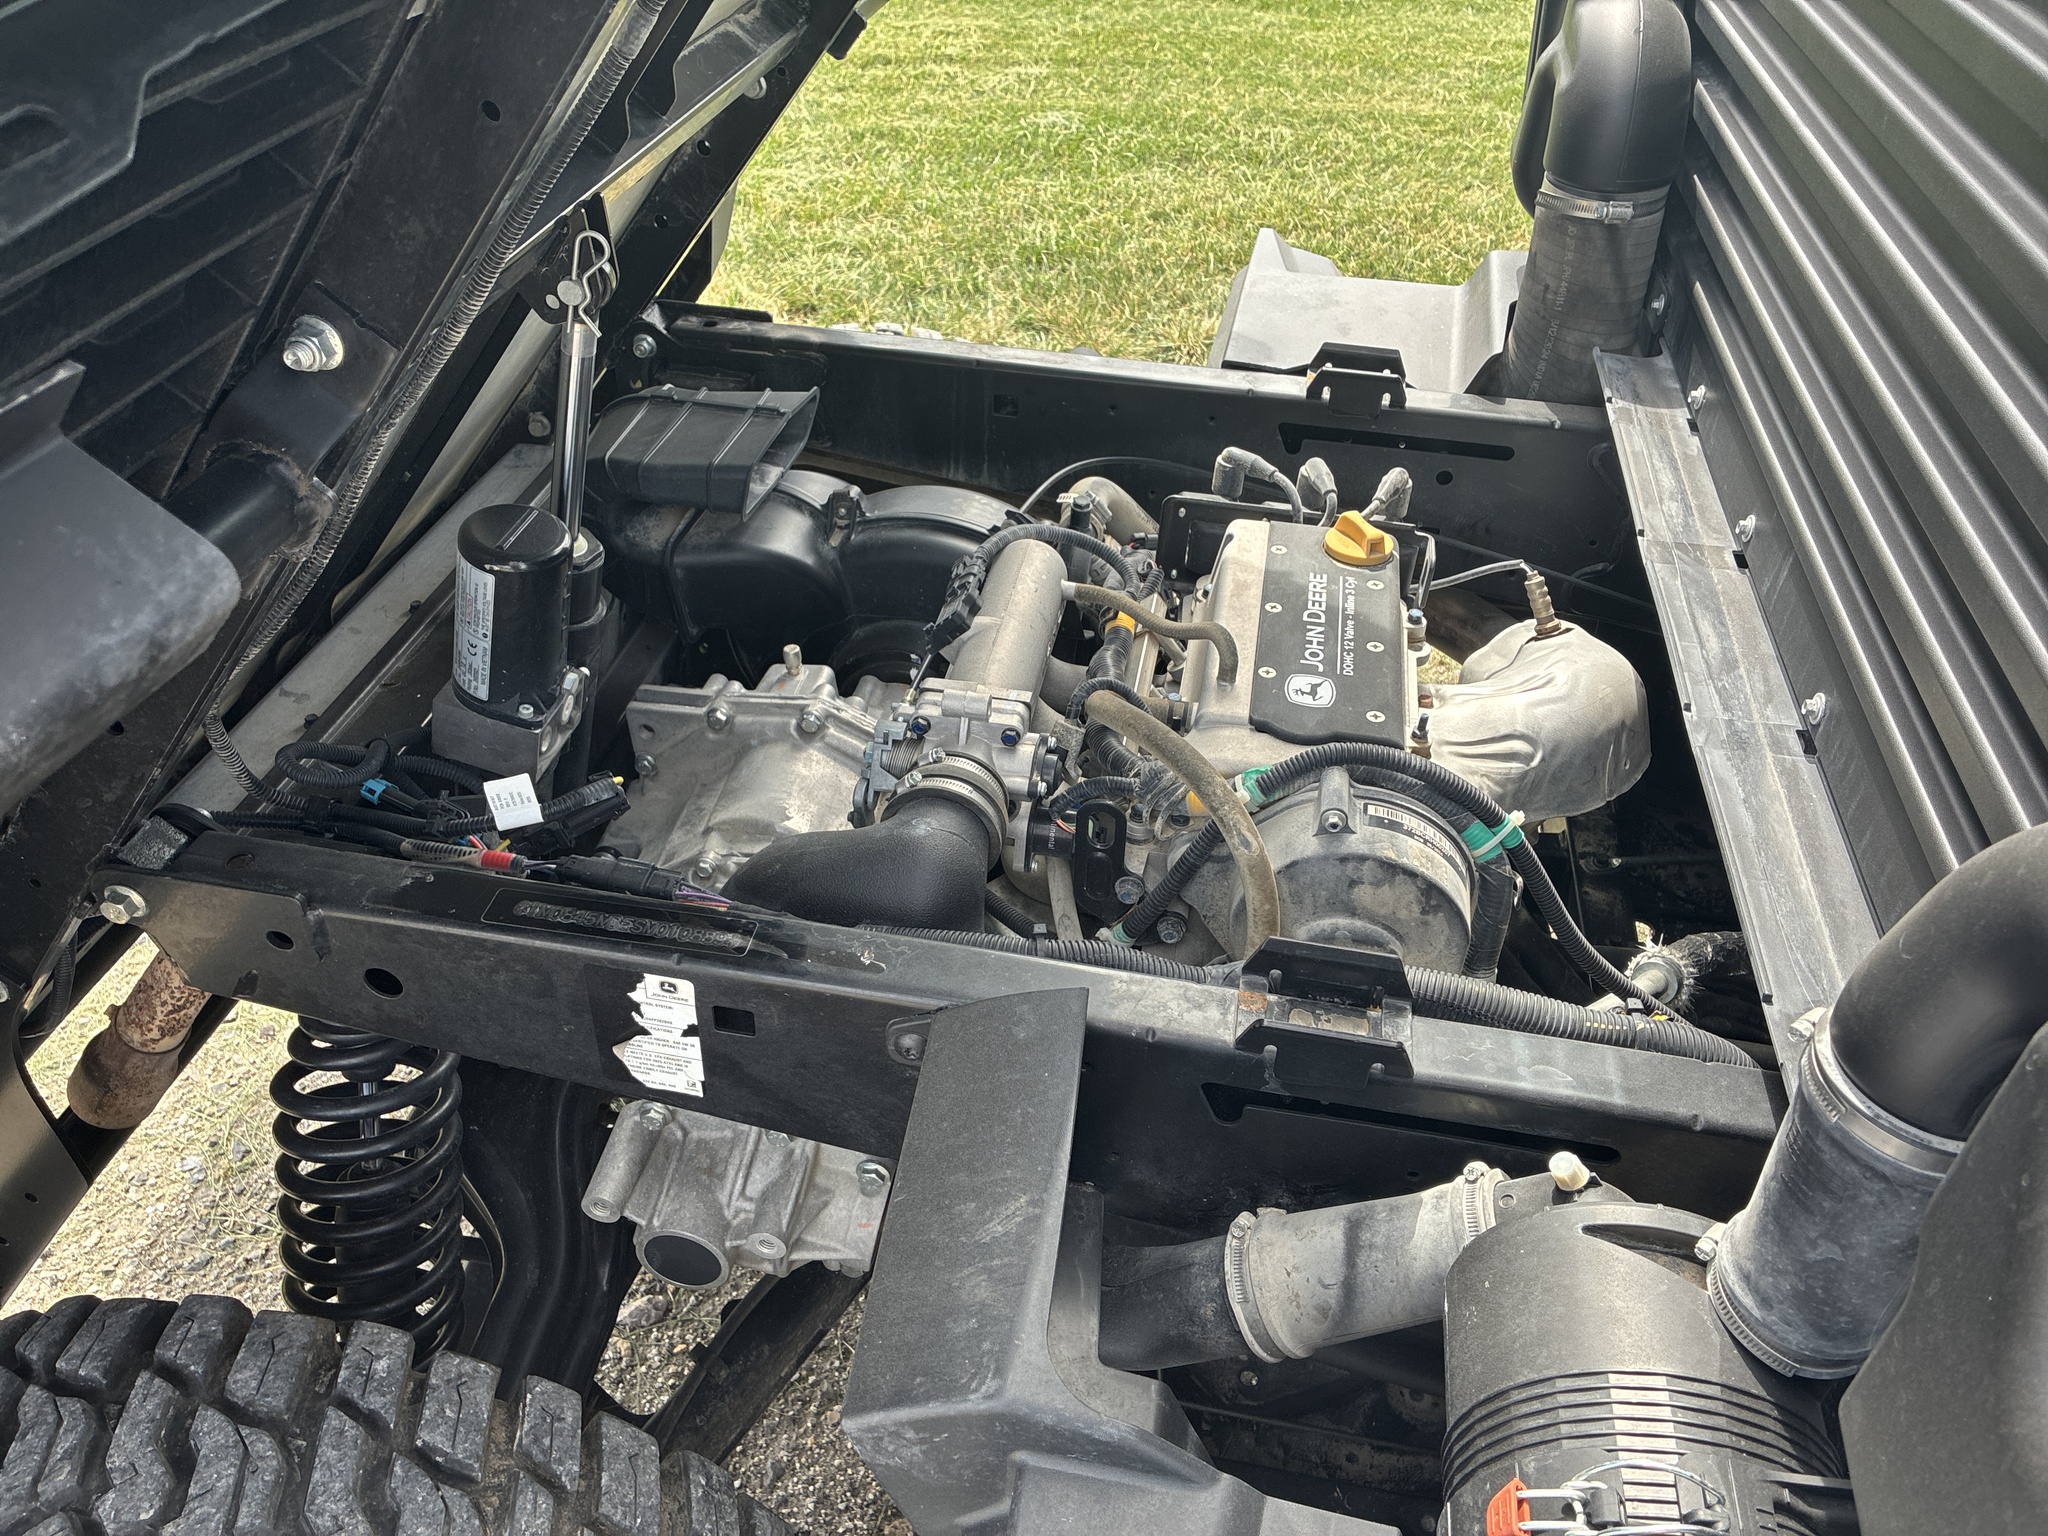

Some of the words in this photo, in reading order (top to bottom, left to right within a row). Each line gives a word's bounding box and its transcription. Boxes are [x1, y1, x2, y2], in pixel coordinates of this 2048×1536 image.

[1345, 576, 1358, 589] Cyl
[1302, 572, 1327, 623] DEERE
[1344, 594, 1355, 615] Inline
[1344, 620, 1354, 639] Valve
[467, 640, 478, 656] CE
[1300, 625, 1325, 672] JOHN
[1343, 641, 1354, 650] 12
[1343, 651, 1354, 676] DOHC
